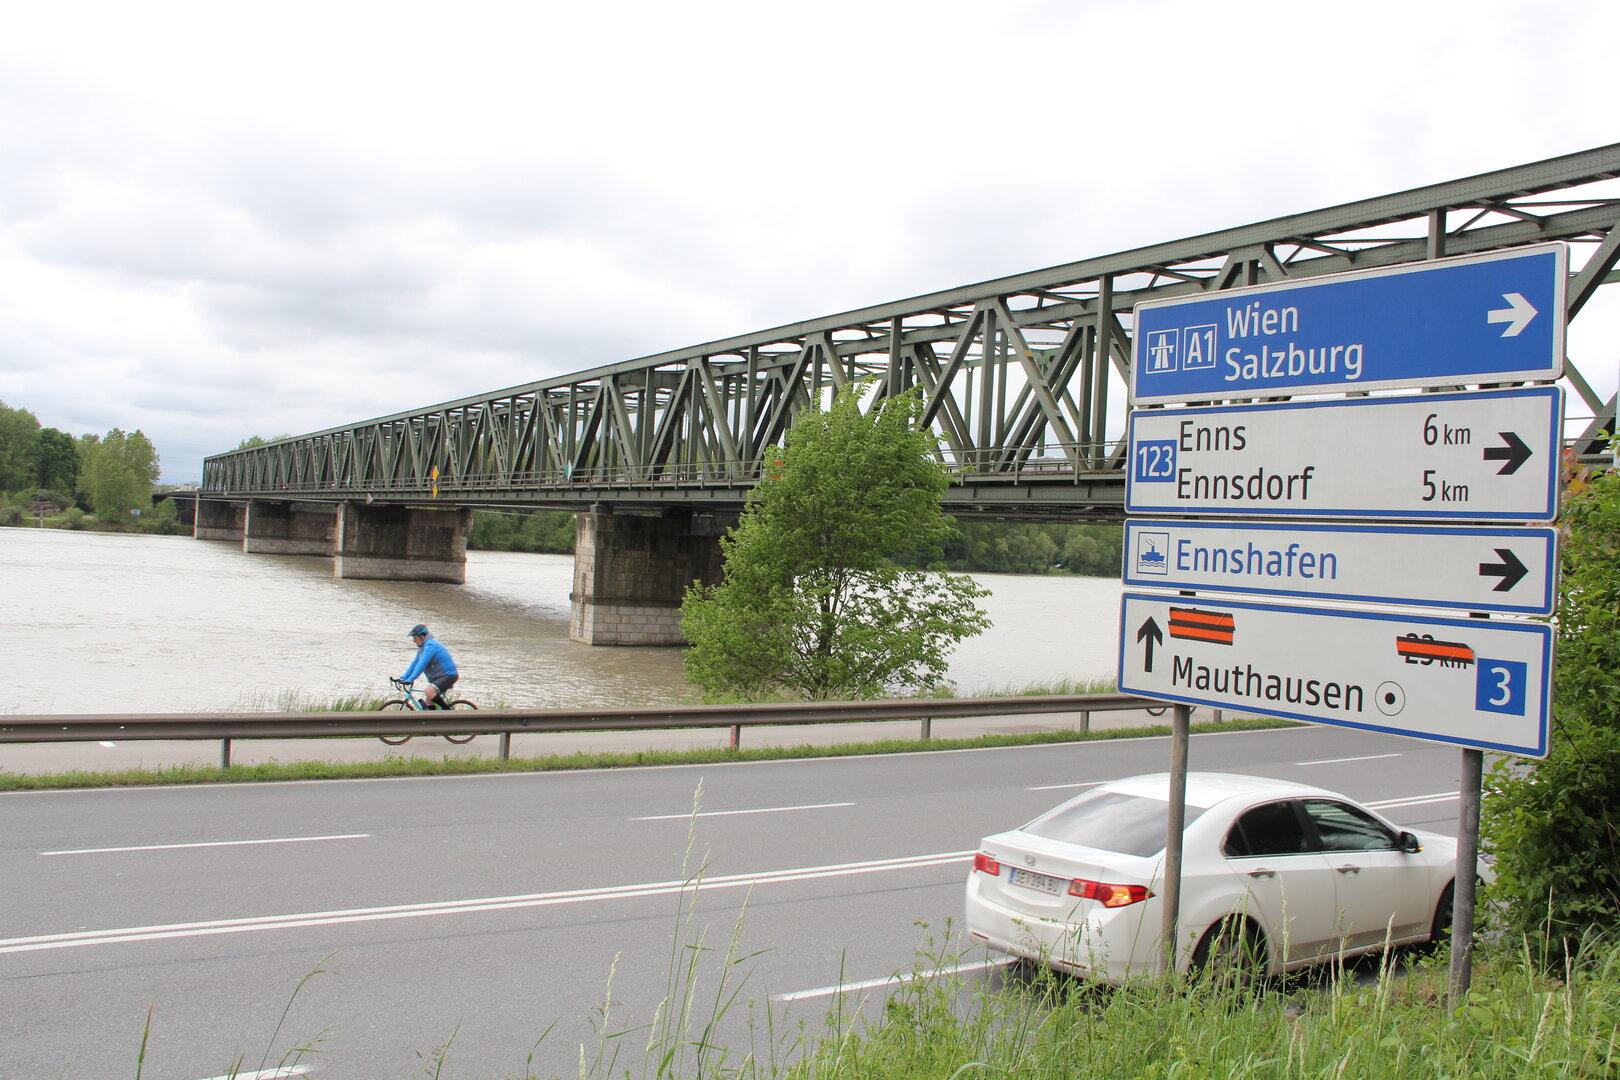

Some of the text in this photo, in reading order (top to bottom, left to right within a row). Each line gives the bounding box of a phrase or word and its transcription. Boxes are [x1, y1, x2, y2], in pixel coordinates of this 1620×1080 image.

[1226, 302, 1299, 339] Wien
[1187, 329, 1215, 365] A1
[1224, 343, 1364, 382] Salzburg
[1180, 420, 1246, 452] Enns
[1423, 414, 1471, 446] 6 km
[1138, 444, 1173, 478] 123
[1177, 466, 1315, 500] Ennsdorf
[1422, 470, 1469, 502] 5 km
[1177, 539, 1337, 580] Ennshafen
[1172, 655, 1363, 712] Mauthausen
[1488, 666, 1512, 707] 3
